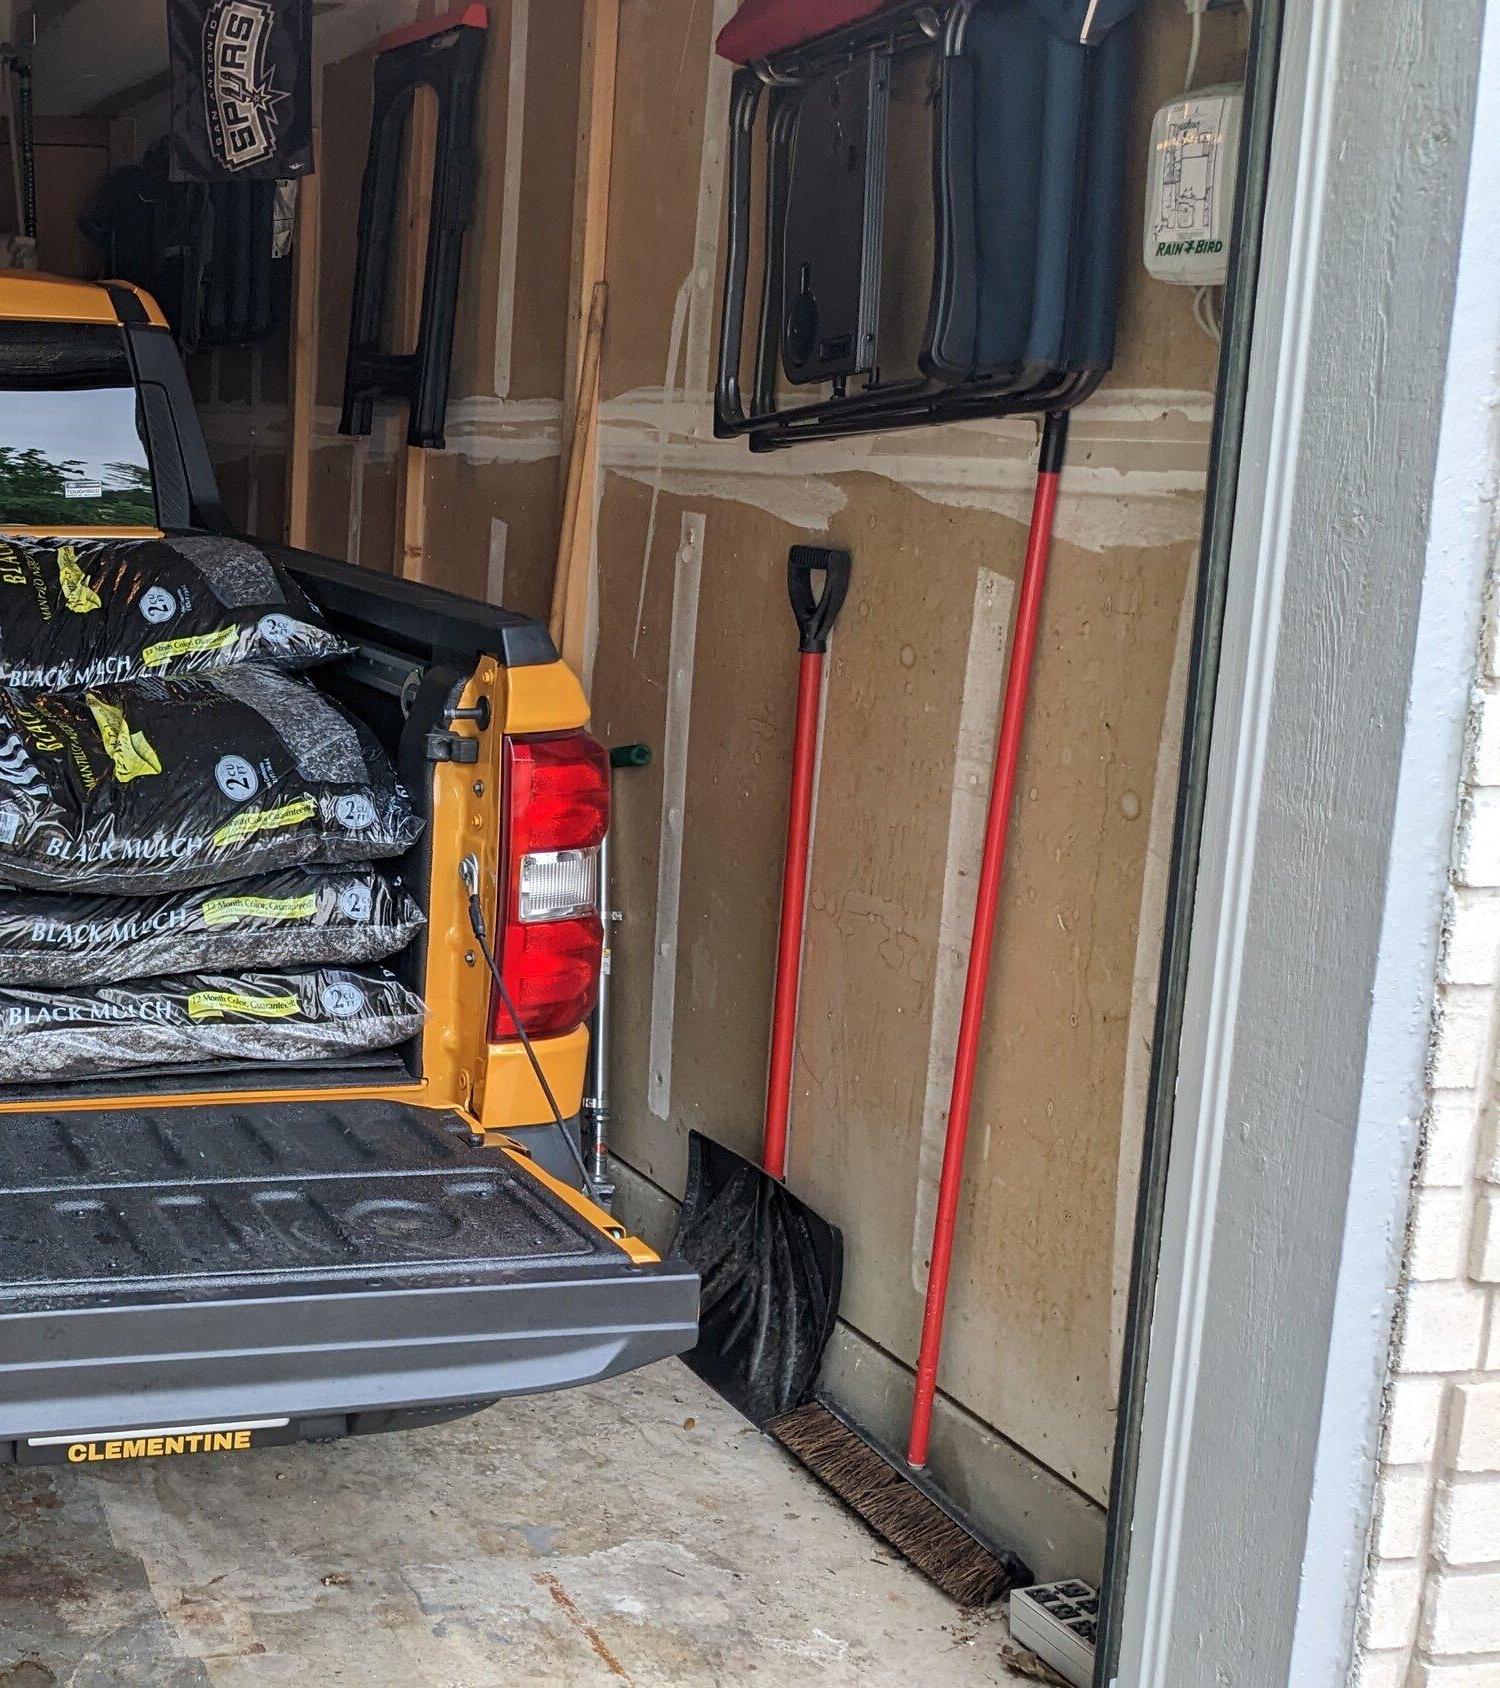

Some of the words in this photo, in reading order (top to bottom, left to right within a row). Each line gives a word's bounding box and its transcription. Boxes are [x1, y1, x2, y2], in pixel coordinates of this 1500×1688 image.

[206, 19, 217, 100] ANTONIO
[219, 13, 257, 153] SPURS
[211, 110, 223, 146] SAN
[1156, 242, 1184, 257] RAIN
[1194, 240, 1224, 254] BIRD
[147, 603, 169, 617] 2
[9, 670, 71, 687] BLACK
[226, 764, 237, 777] CU
[237, 764, 248, 776] FT
[226, 777, 251, 791] 2
[344, 800, 356, 820] 2
[356, 814, 366, 822] FT
[357, 806, 368, 814] CU
[45, 837, 114, 862] BLACK
[120, 836, 203, 860] MULCH
[218, 900, 243, 909] Month
[244, 899, 268, 911] Color,
[350, 892, 361, 912] 2
[31, 921, 102, 944] BLACK
[192, 995, 201, 1005] 12
[203, 993, 226, 1003] Month
[227, 996, 249, 1008] Color,
[250, 998, 296, 1010] Guaranteed!
[330, 989, 345, 1009] 2
[344, 992, 355, 1000] CU
[9, 1006, 82, 1027] BLACK
[67, 1430, 252, 1465] CLEMENTINE
